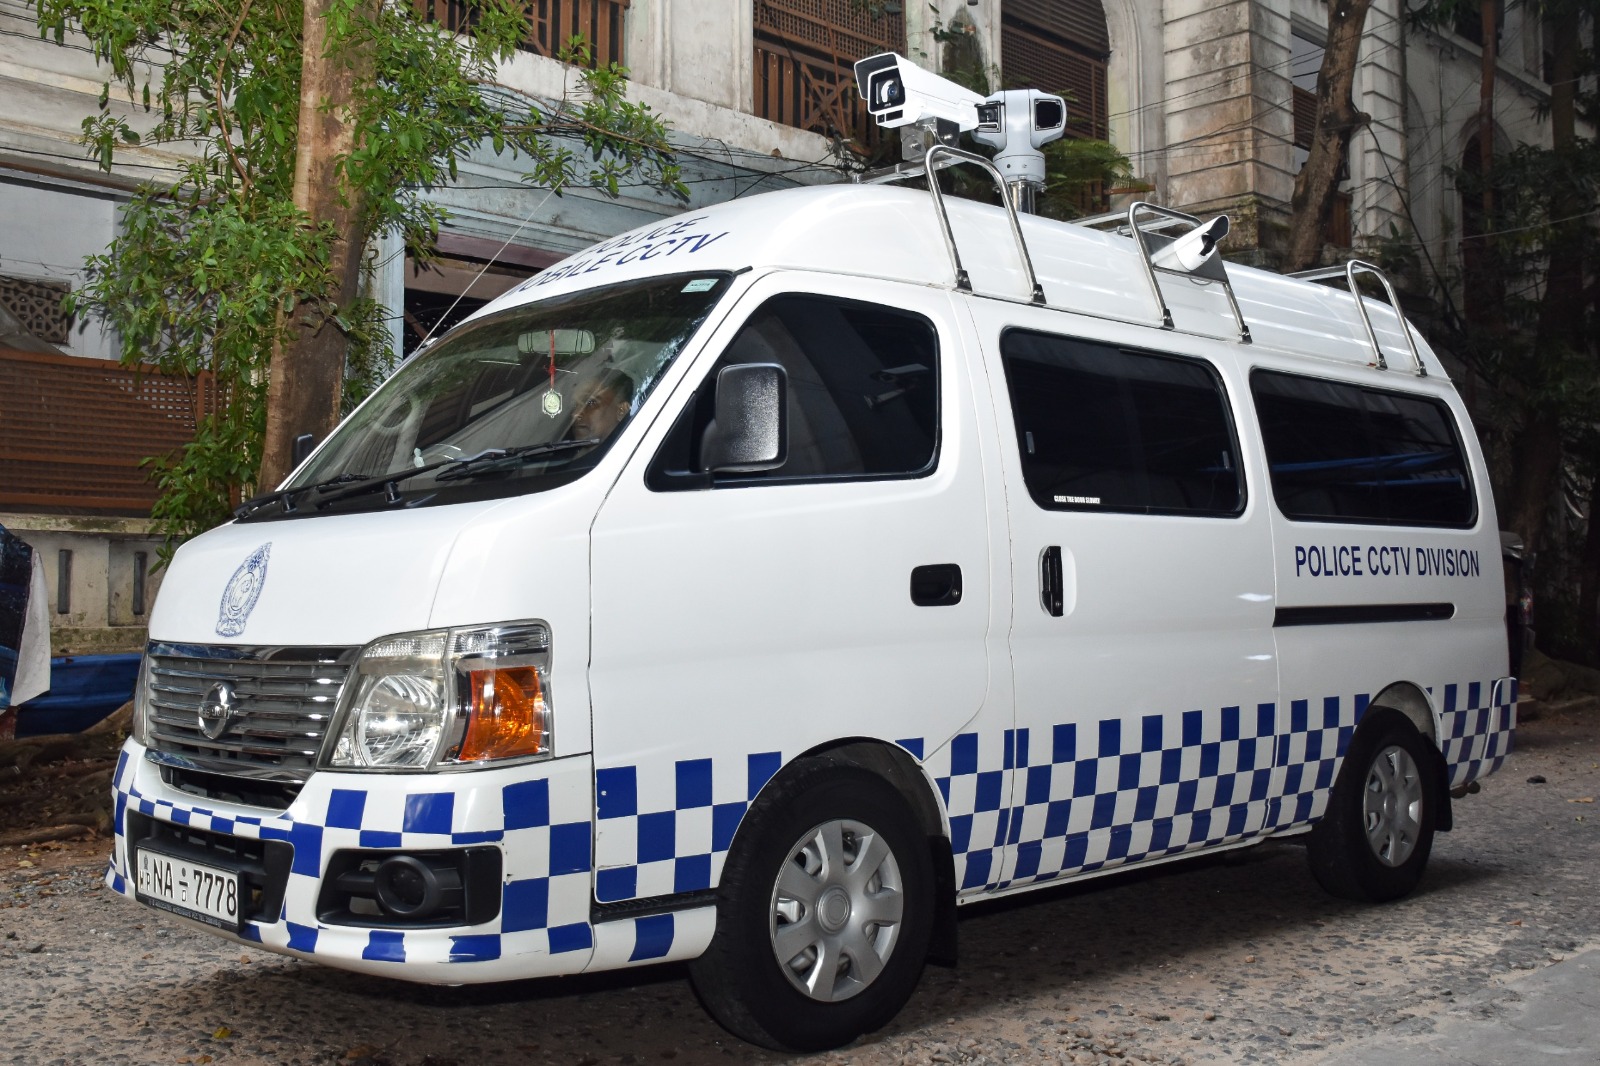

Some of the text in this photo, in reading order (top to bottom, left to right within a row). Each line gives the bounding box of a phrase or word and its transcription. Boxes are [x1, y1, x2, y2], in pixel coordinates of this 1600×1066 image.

[573, 215, 709, 262] POLICE
[616, 231, 730, 266] CCTV
[1295, 546, 1480, 577] POLICE CCTV DIVISION
[154, 858, 174, 899] NA
[193, 869, 237, 917] 7778
